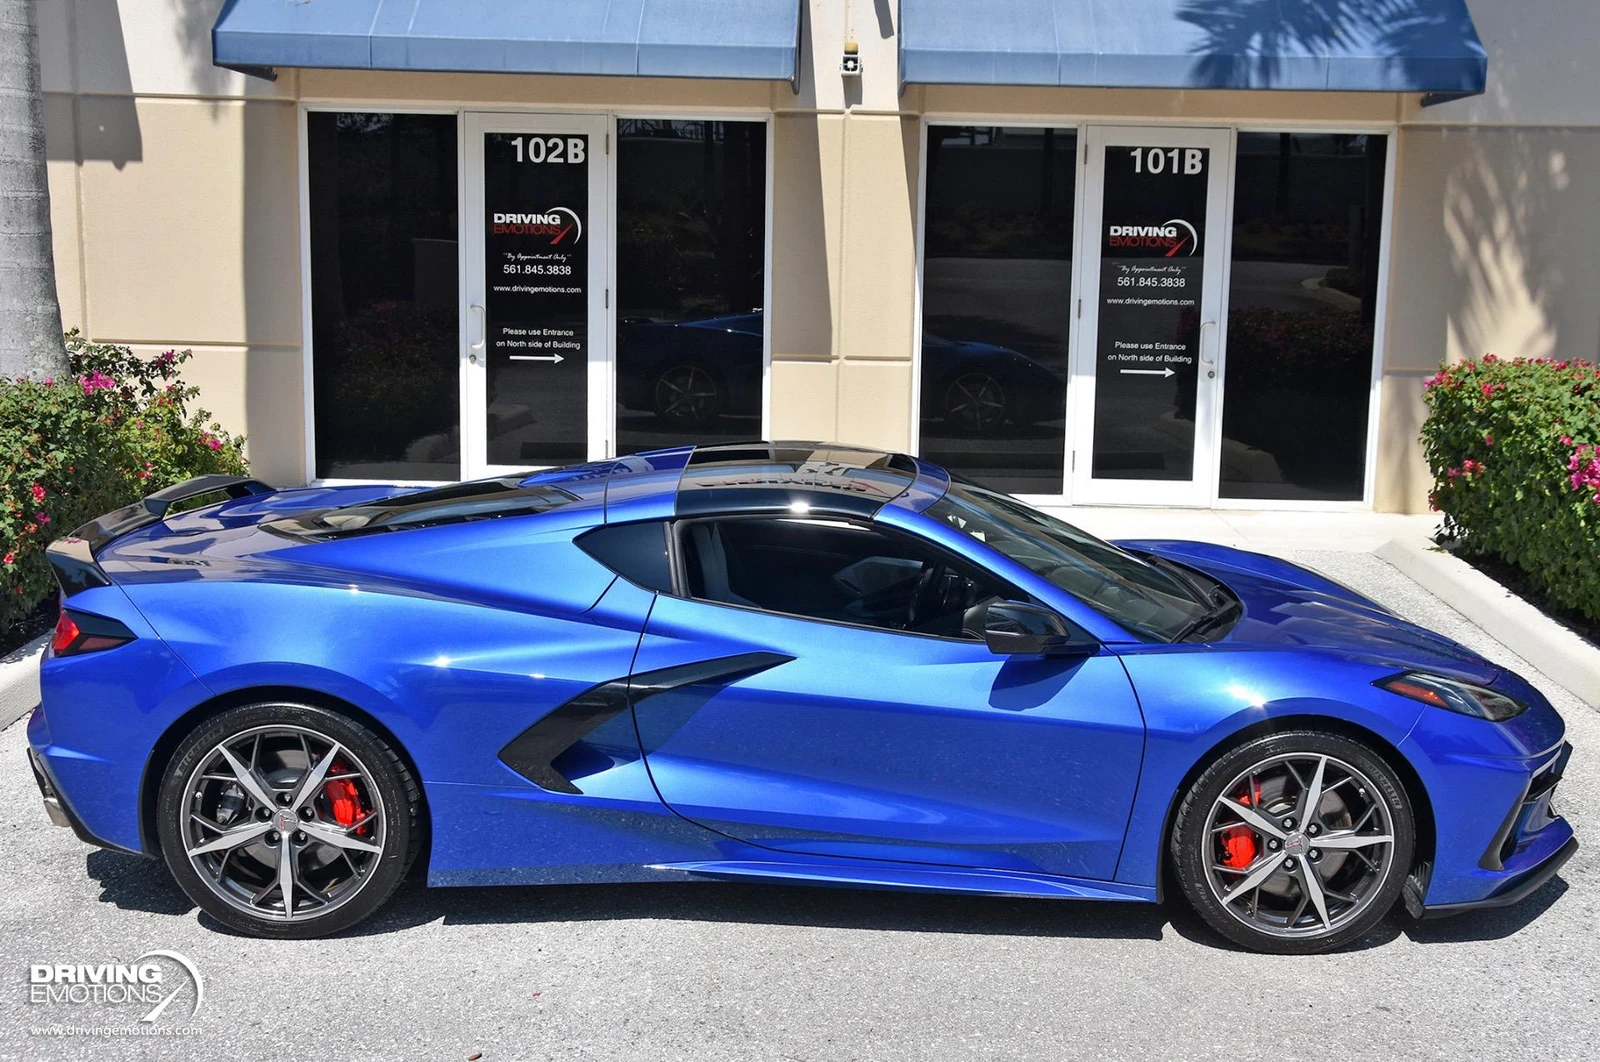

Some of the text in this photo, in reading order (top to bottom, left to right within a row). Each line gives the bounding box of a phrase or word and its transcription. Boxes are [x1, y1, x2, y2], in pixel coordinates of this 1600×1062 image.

[511, 136, 585, 164] 102B
[1130, 147, 1203, 175] 101B
[493, 213, 561, 225] DRIVING
[493, 224, 561, 235] EMOTIONS
[1109, 225, 1177, 237] DRIVING
[1109, 236, 1177, 247] EMOTIONS
[517, 252, 553, 261] Appointment
[503, 264, 572, 275] 561.845.3838
[1131, 265, 1167, 274] Appointment
[1117, 276, 1186, 288] 561.845.3838
[493, 285, 582, 294] www.drivingemotions.com
[1106, 297, 1195, 306] www.drivingemotions.com
[502, 327, 527, 336] Please
[543, 328, 574, 337] Entrance
[507, 340, 527, 348] North
[528, 340, 543, 348] side
[552, 341, 581, 351] Building
[1114, 341, 1139, 350] Please
[1154, 342, 1186, 351] Entrance
[1139, 354, 1154, 362] side
[1164, 355, 1193, 365] Building
